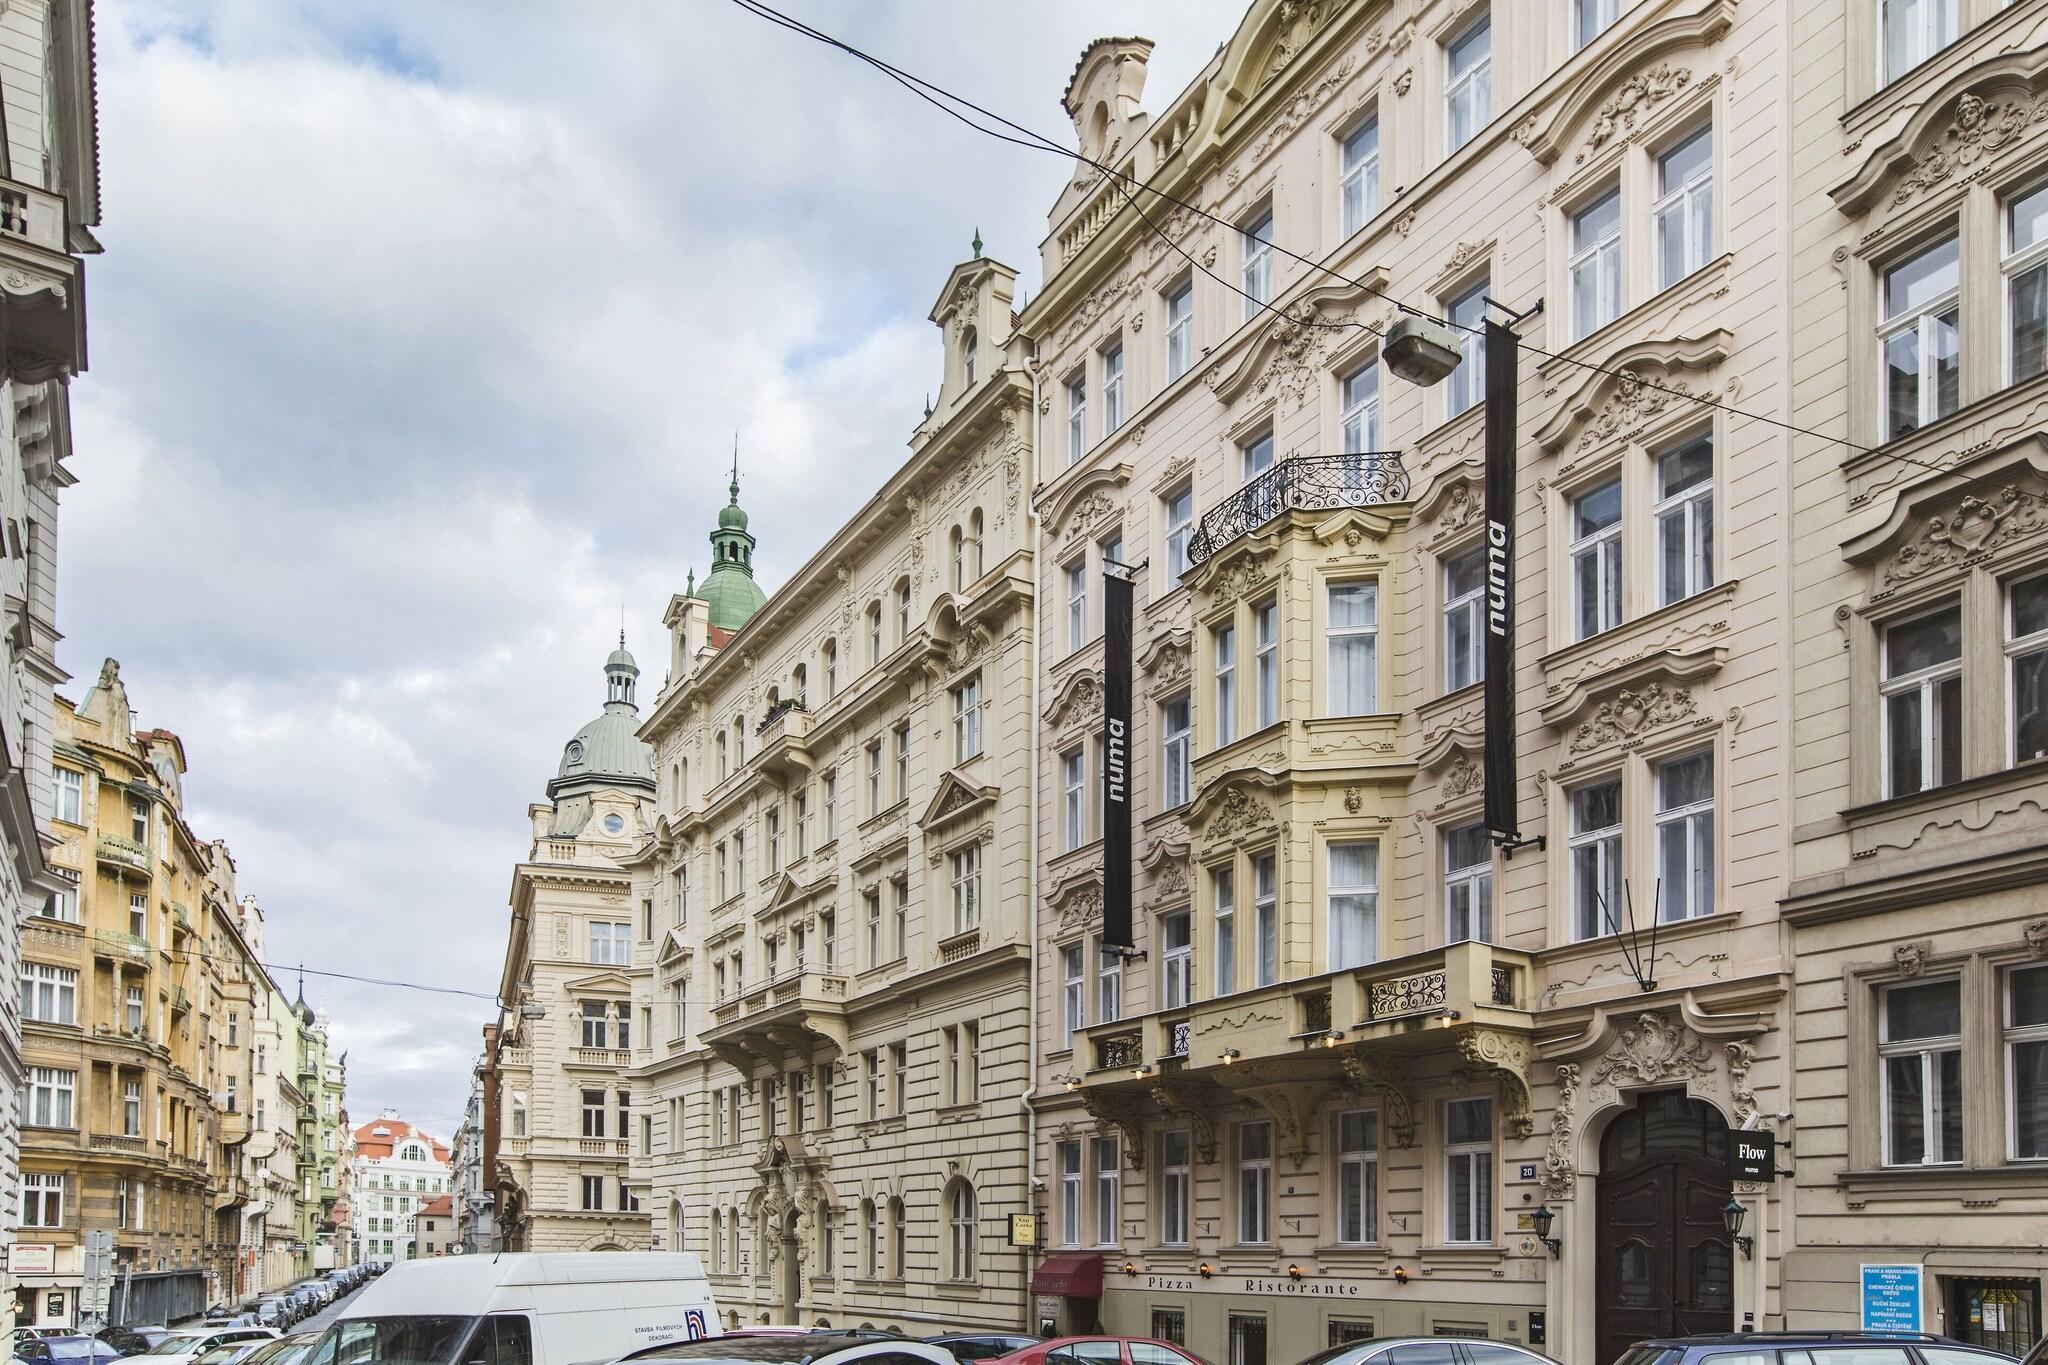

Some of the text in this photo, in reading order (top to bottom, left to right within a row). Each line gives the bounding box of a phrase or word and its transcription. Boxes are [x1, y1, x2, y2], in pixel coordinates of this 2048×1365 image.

[1489, 519, 1506, 636] numa
[1109, 717, 1124, 802] numa
[1738, 1143, 1767, 1160] Flow
[1523, 1167, 1533, 1176] 20
[1148, 1277, 1358, 1295] Pizza Ristorante
